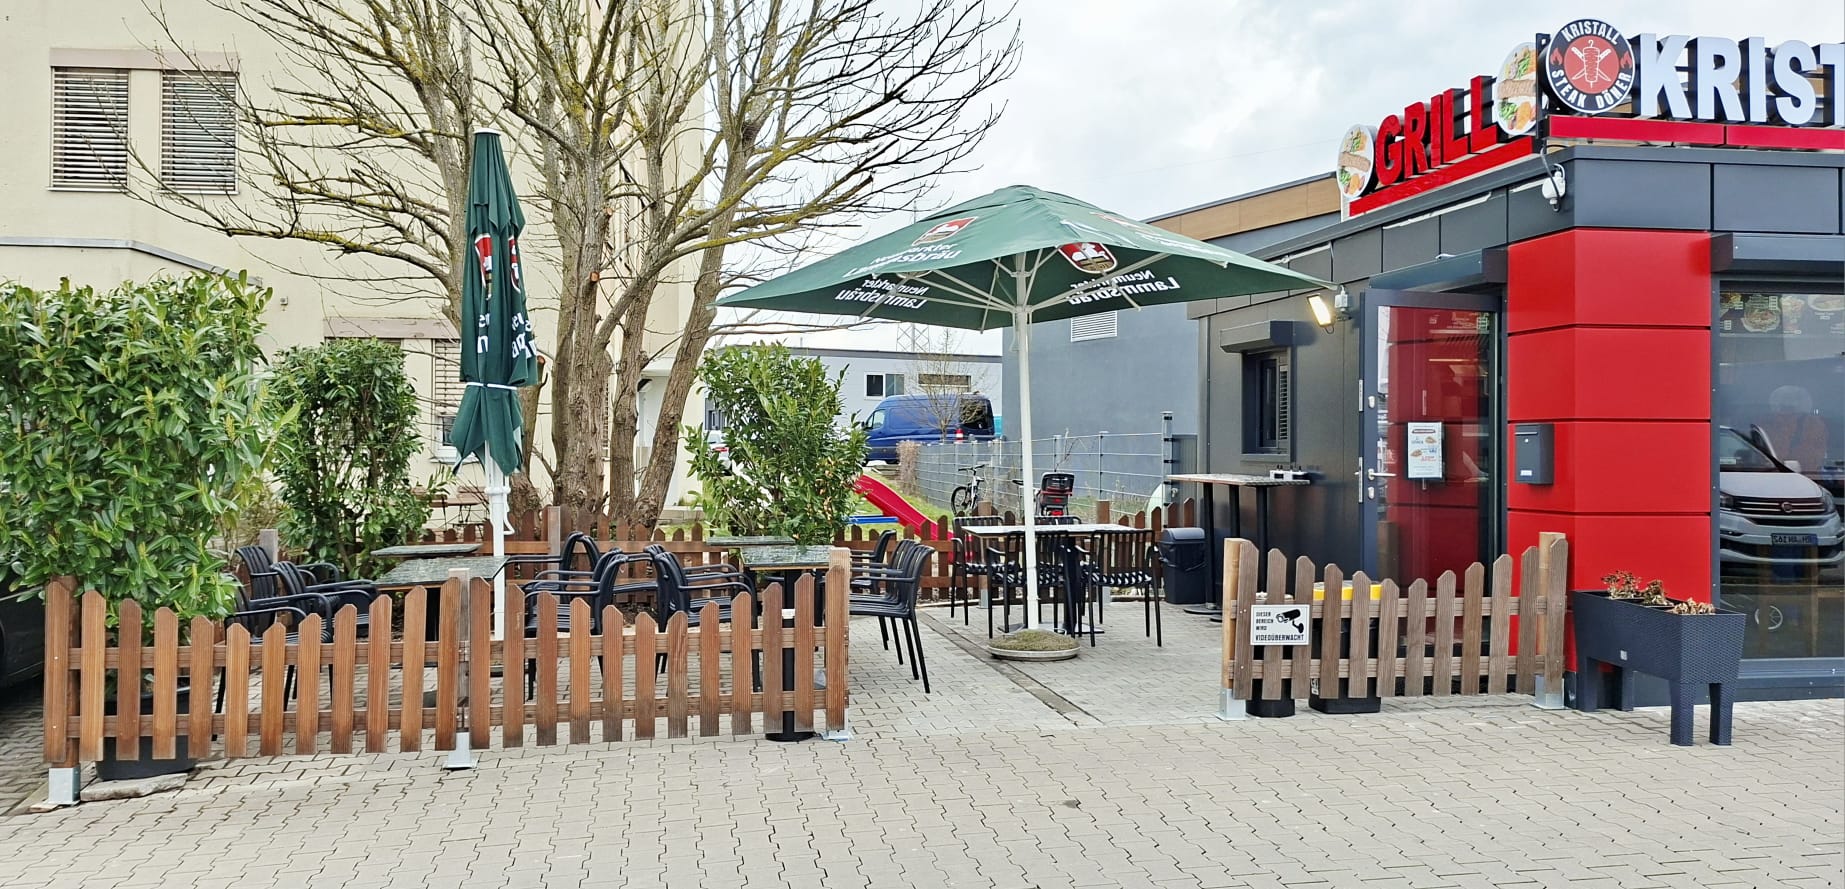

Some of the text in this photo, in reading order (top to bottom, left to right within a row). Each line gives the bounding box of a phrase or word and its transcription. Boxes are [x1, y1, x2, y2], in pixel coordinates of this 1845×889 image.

[1561, 21, 1620, 45] KRISTALL
[1551, 69, 1632, 109] STEAK DÖNER
[1640, 33, 1845, 126] KRIST
[1376, 75, 1498, 186] GRILL
